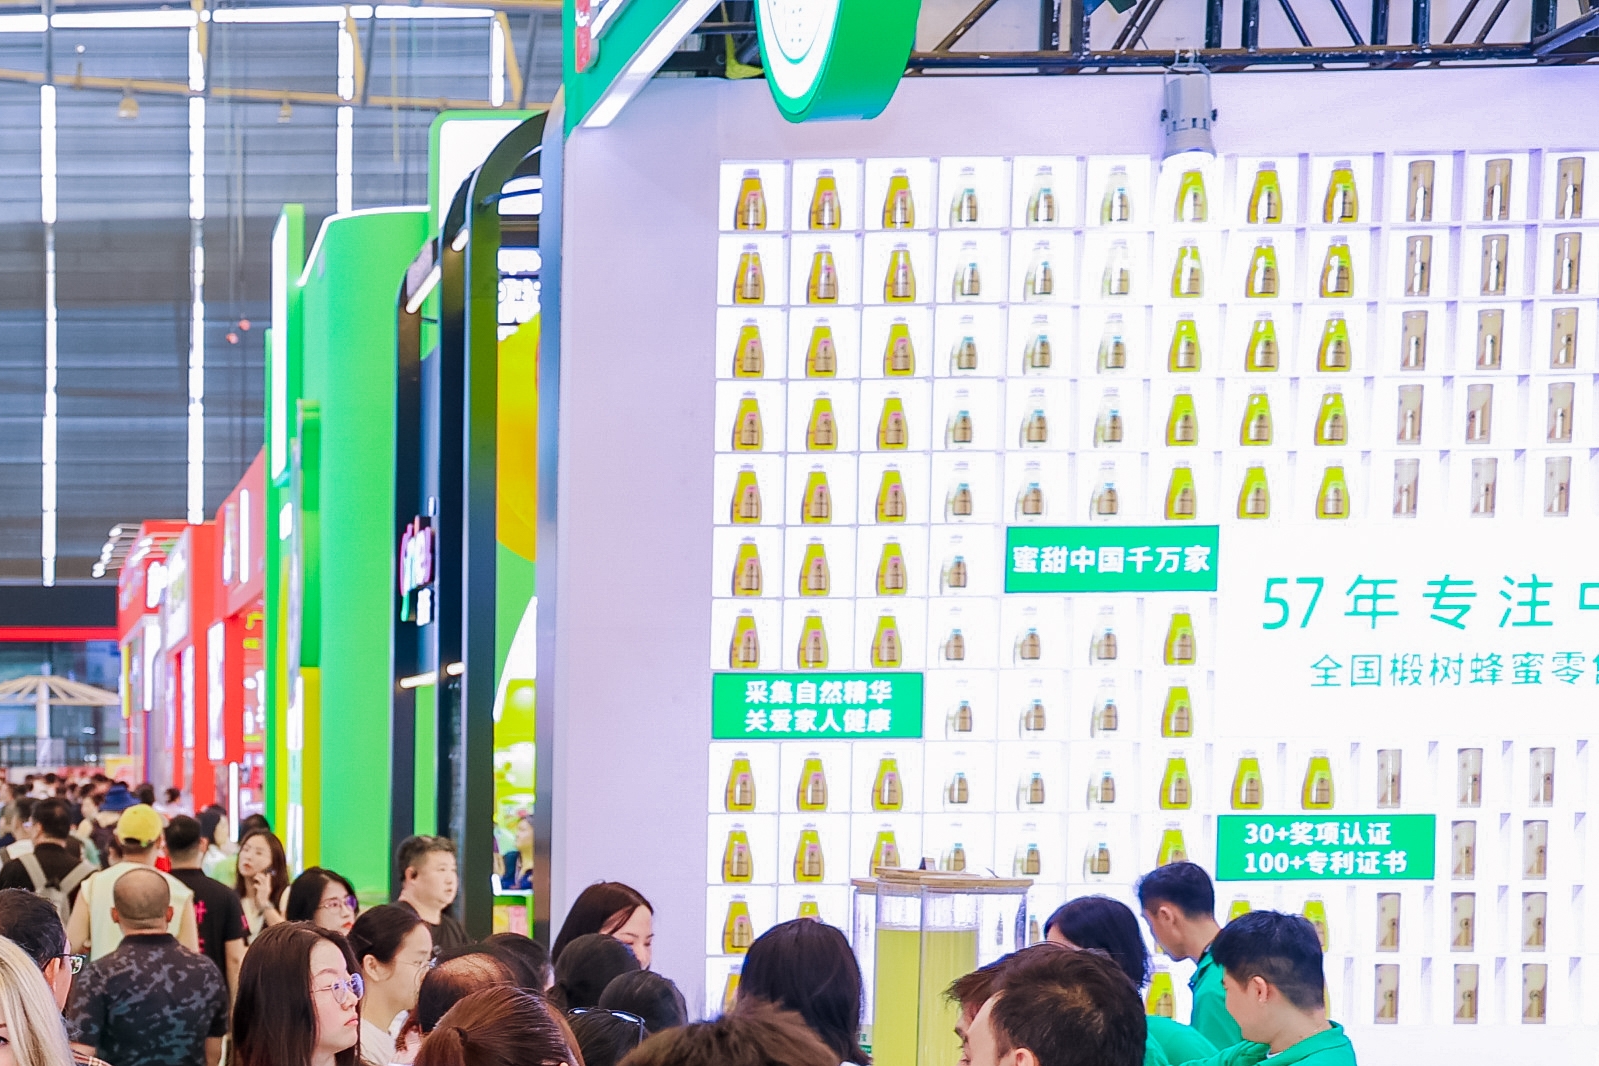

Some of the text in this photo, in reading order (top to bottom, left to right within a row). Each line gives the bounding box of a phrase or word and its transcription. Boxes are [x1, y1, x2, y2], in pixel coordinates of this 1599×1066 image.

[1012, 545, 1211, 573] 蜜甜中国千万家
[1309, 652, 1599, 687] 全国椴树蜂蜜零
[745, 680, 893, 704] 采集自然精华
[744, 708, 892, 733] 关爱家人健康
[1244, 821, 1391, 846] 30+奖项认证
[1244, 850, 1407, 874] 100+专利证书
